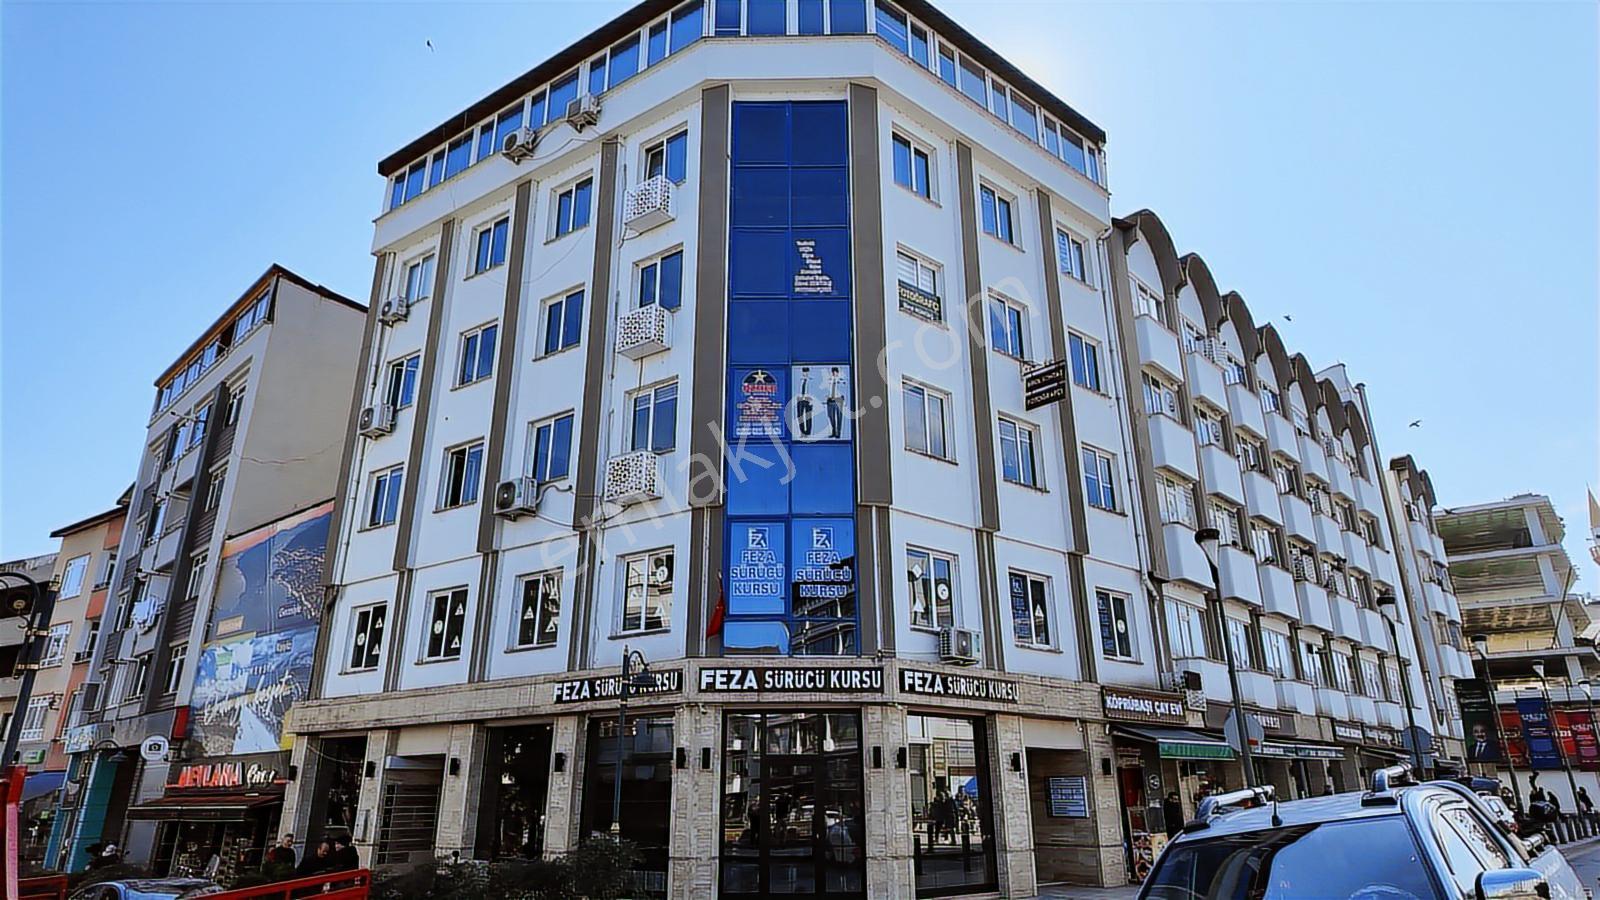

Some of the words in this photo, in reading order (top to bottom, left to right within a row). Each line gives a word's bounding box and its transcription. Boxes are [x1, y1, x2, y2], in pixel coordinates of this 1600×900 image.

[741, 550, 776, 564] FEZA
[806, 551, 841, 565] FEZA
[730, 563, 785, 580] SÜRÜCÜ
[795, 565, 852, 582] SÜRÜCÜ
[733, 581, 779, 596] KURSU
[800, 584, 847, 598] KURSU
[700, 669, 758, 690] FEZA
[764, 670, 825, 689] SÜRÜCÜ
[830, 670, 881, 689] KURSU
[904, 670, 944, 694] FEZA
[947, 676, 986, 698] SÜRÜCÜ
[988, 681, 1019, 700] KURSU
[553, 680, 590, 702] FEZA
[1105, 694, 1153, 716] KÖPRÜBAŞI
